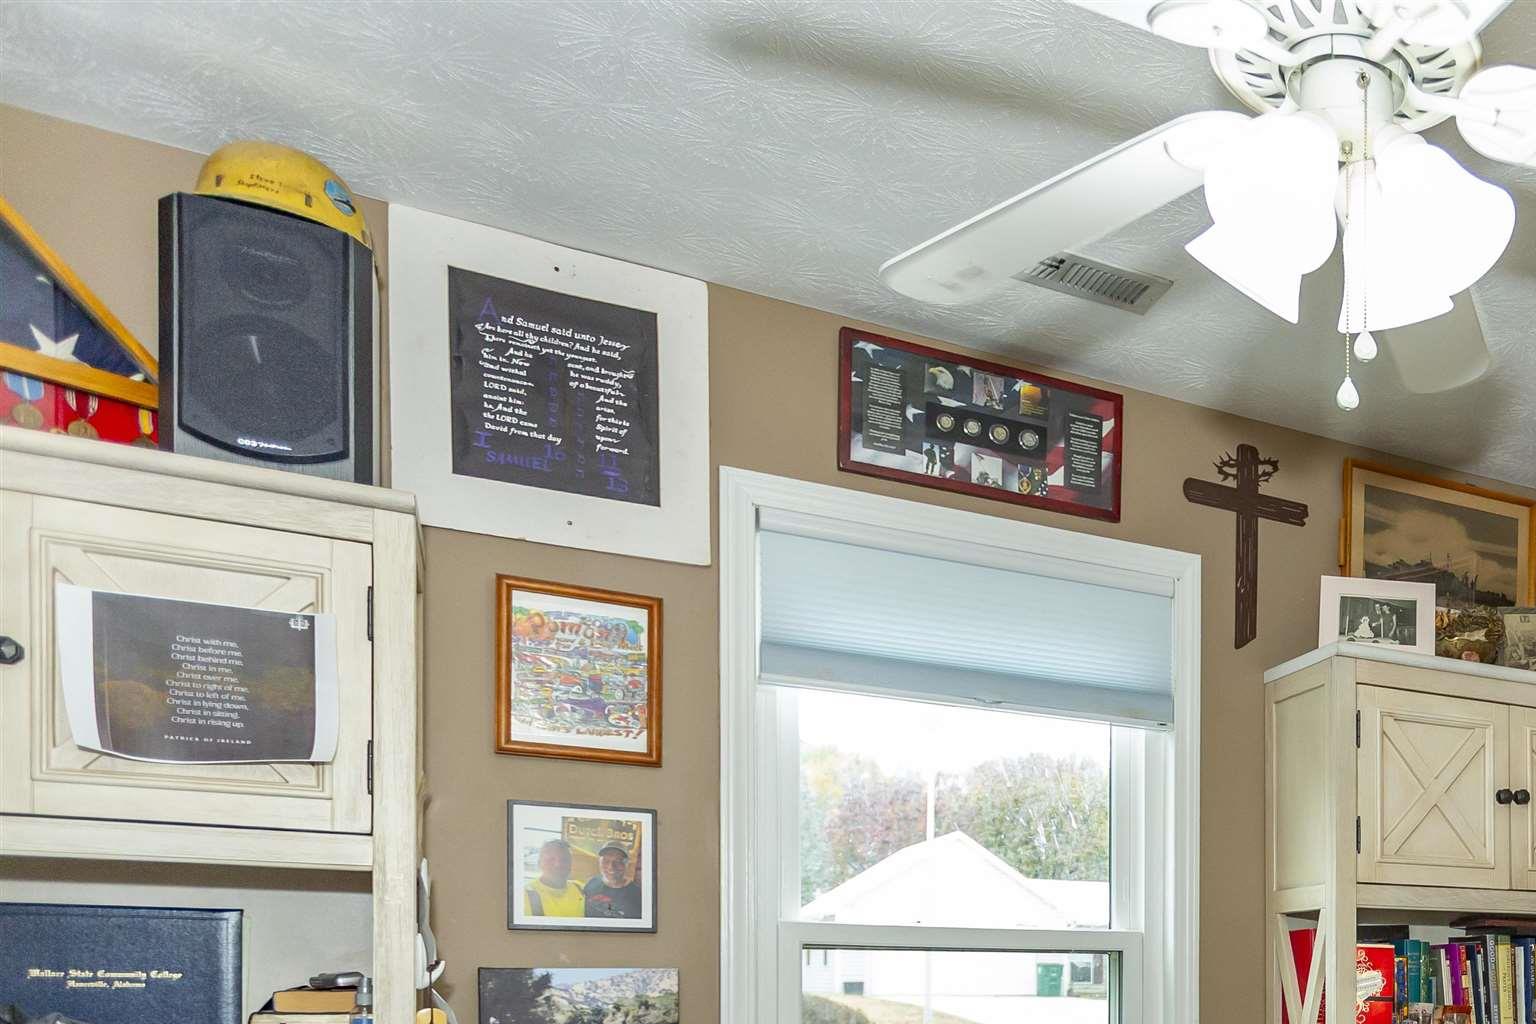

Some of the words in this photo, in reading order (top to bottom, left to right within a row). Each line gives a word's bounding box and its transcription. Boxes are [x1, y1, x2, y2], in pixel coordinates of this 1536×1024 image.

[515, 317, 549, 332] Samuel
[550, 327, 573, 338] said
[574, 332, 596, 343] unto
[66, 968, 94, 979] State
[150, 969, 184, 981] College
